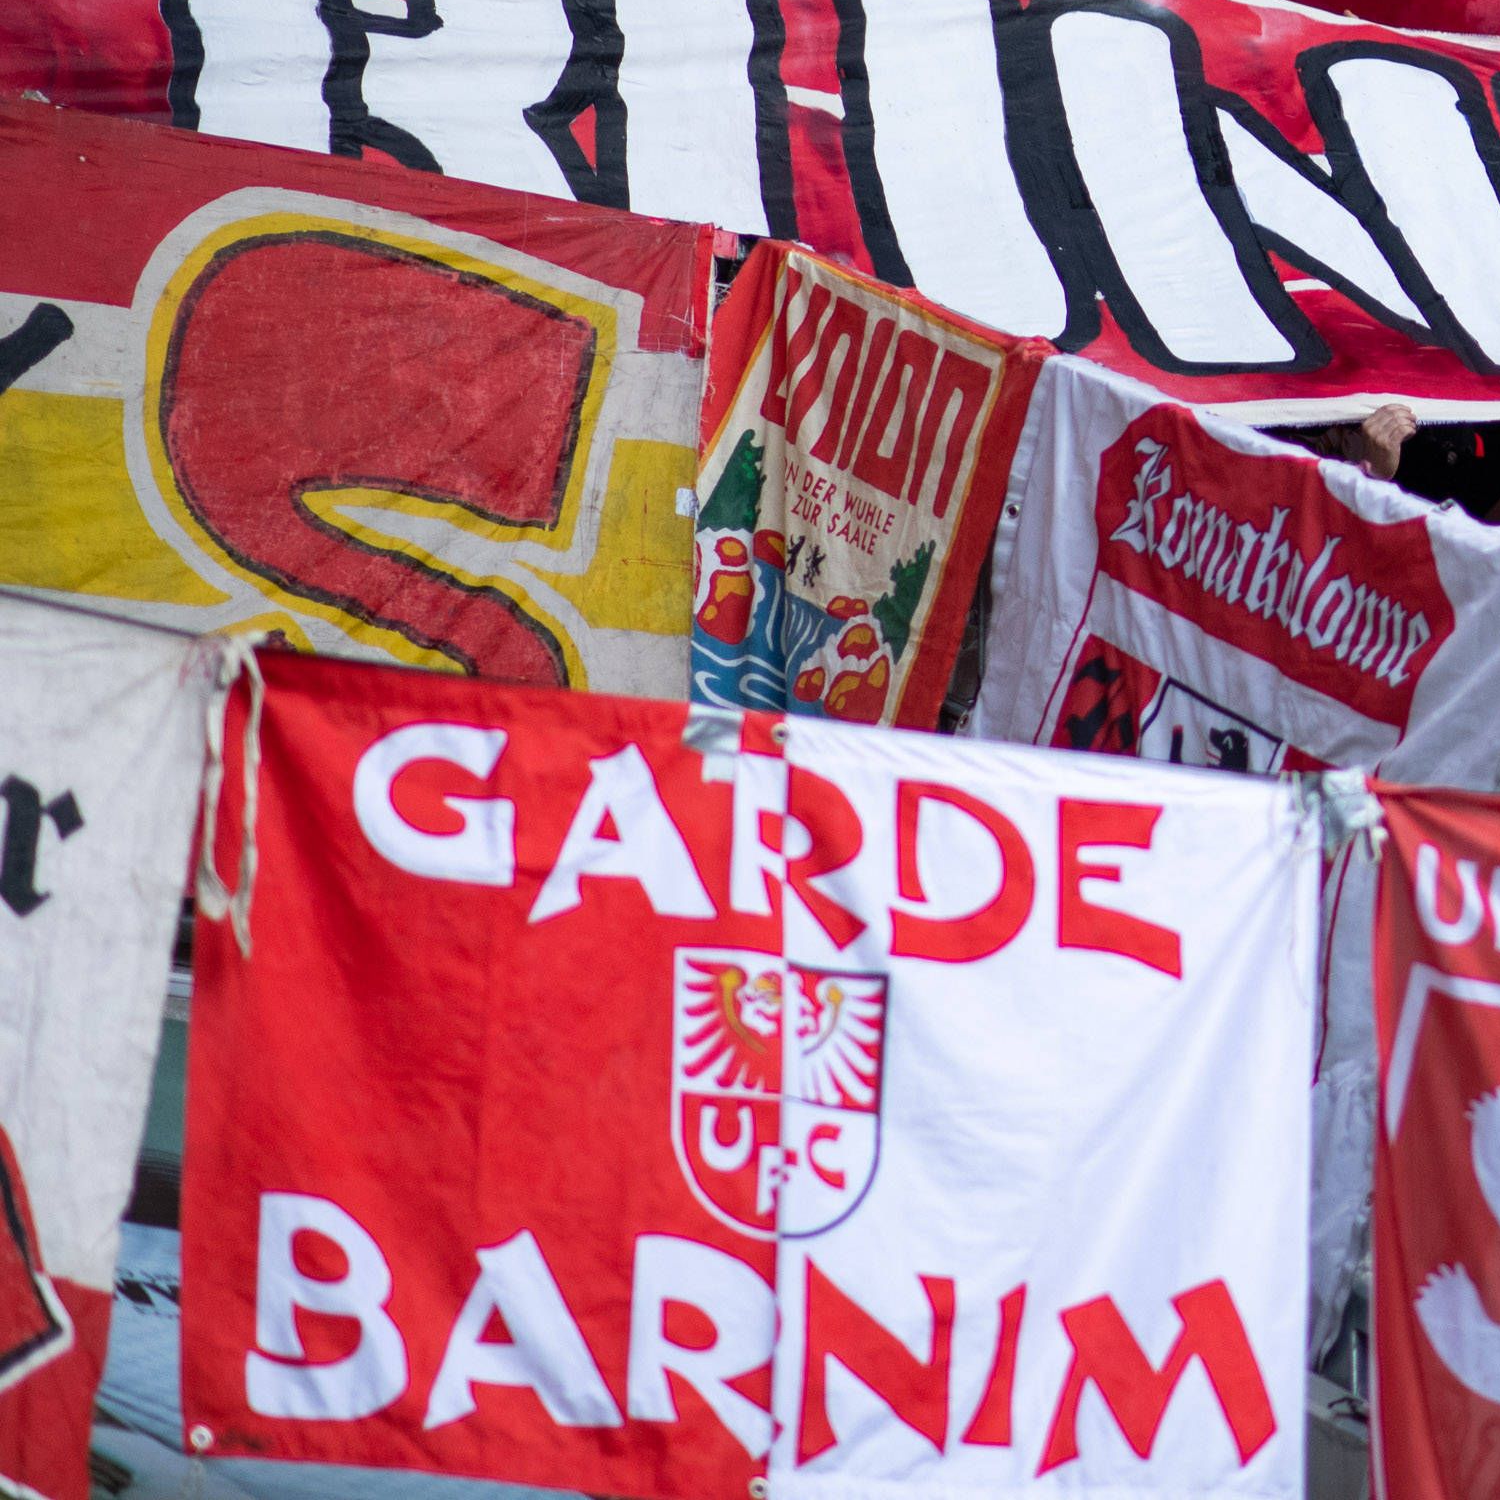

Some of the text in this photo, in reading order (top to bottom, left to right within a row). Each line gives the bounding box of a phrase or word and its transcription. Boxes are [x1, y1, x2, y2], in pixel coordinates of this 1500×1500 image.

[760, 267, 994, 520] UNION
[802, 469, 837, 506] DER
[843, 490, 896, 535] WUHLE
[791, 494, 878, 556] ZUR SAALE
[353, 721, 1184, 980] GARDE
[245, 1191, 1278, 1478] BARNIM
